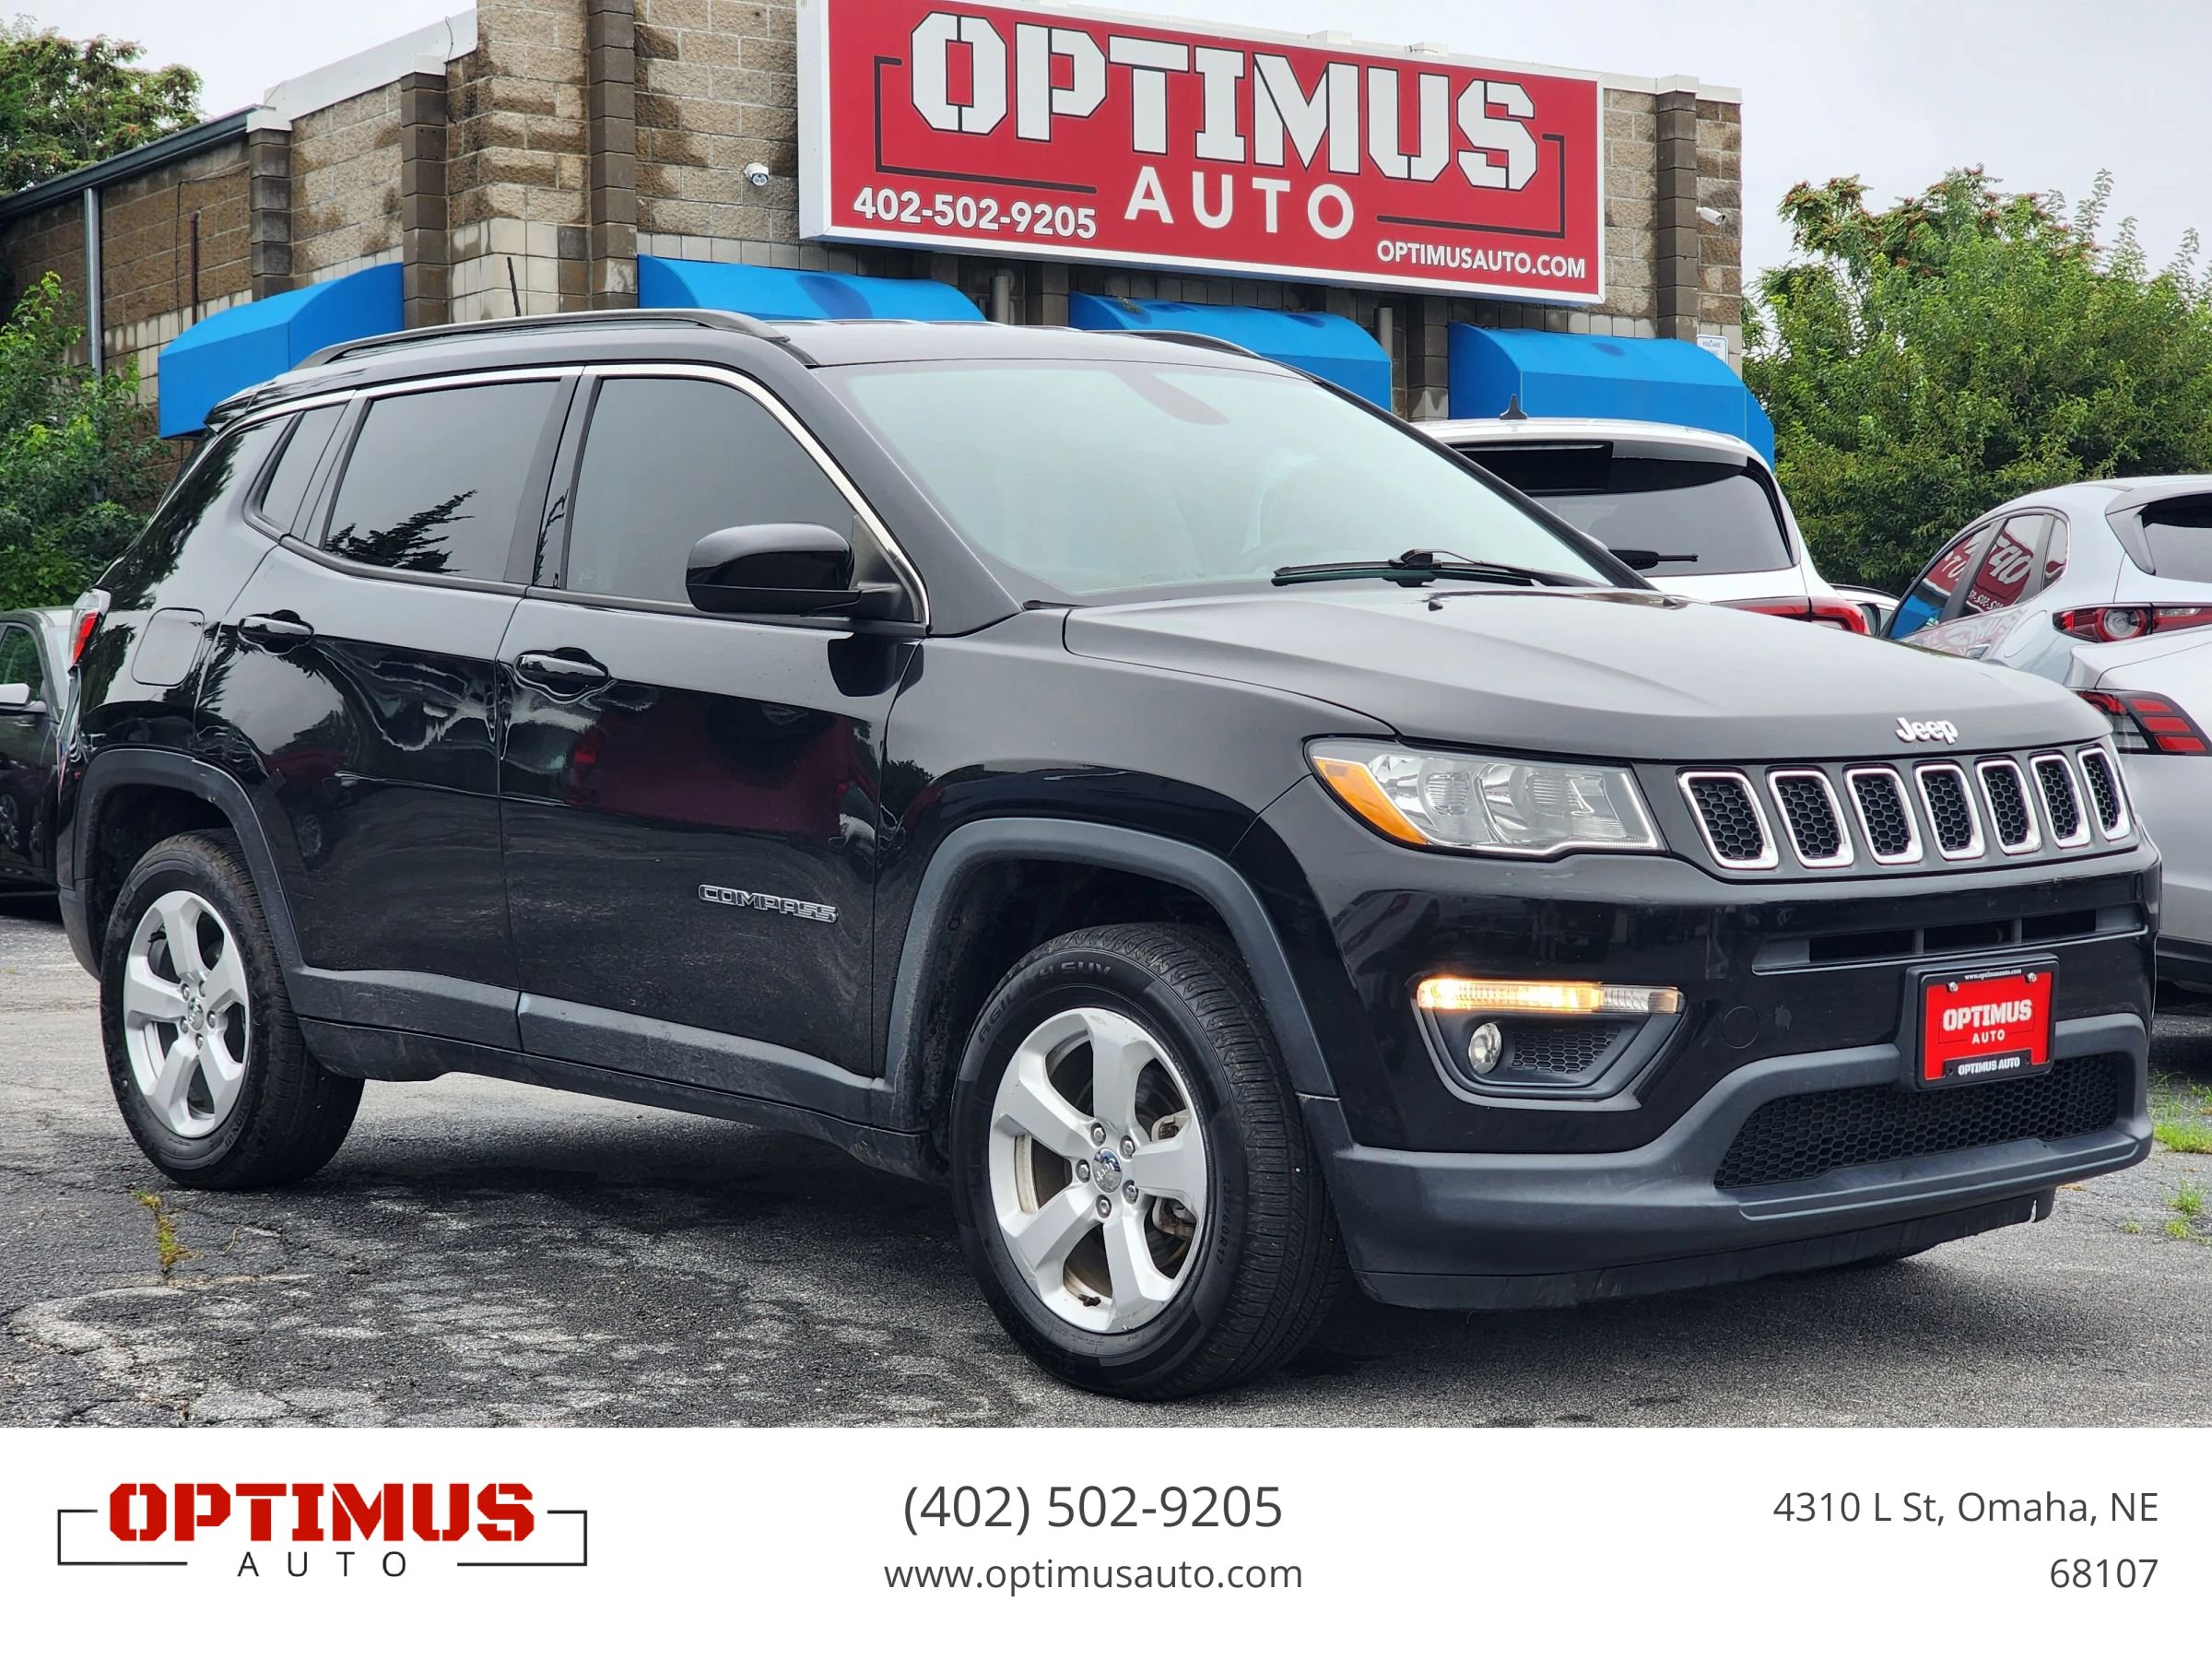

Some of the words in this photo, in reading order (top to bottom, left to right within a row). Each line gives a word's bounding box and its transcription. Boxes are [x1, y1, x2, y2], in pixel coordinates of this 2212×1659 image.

[911, 11, 1539, 191] OPTIMUS
[853, 186, 1097, 240] 402-502-9205
[1124, 165, 1355, 240] AUTO
[1377, 240, 1585, 279] OPTIMUSAUTO.COM
[1895, 717, 1959, 745] Jeep
[699, 884, 838, 923] COMPASS
[1061, 961, 1112, 974] SUV
[1943, 998, 2032, 1031] OPTIMUS
[1971, 1029, 2006, 1045] AUTO
[1958, 1061, 1997, 1076] OPTIMUS
[1998, 1057, 2020, 1069] AUTO
